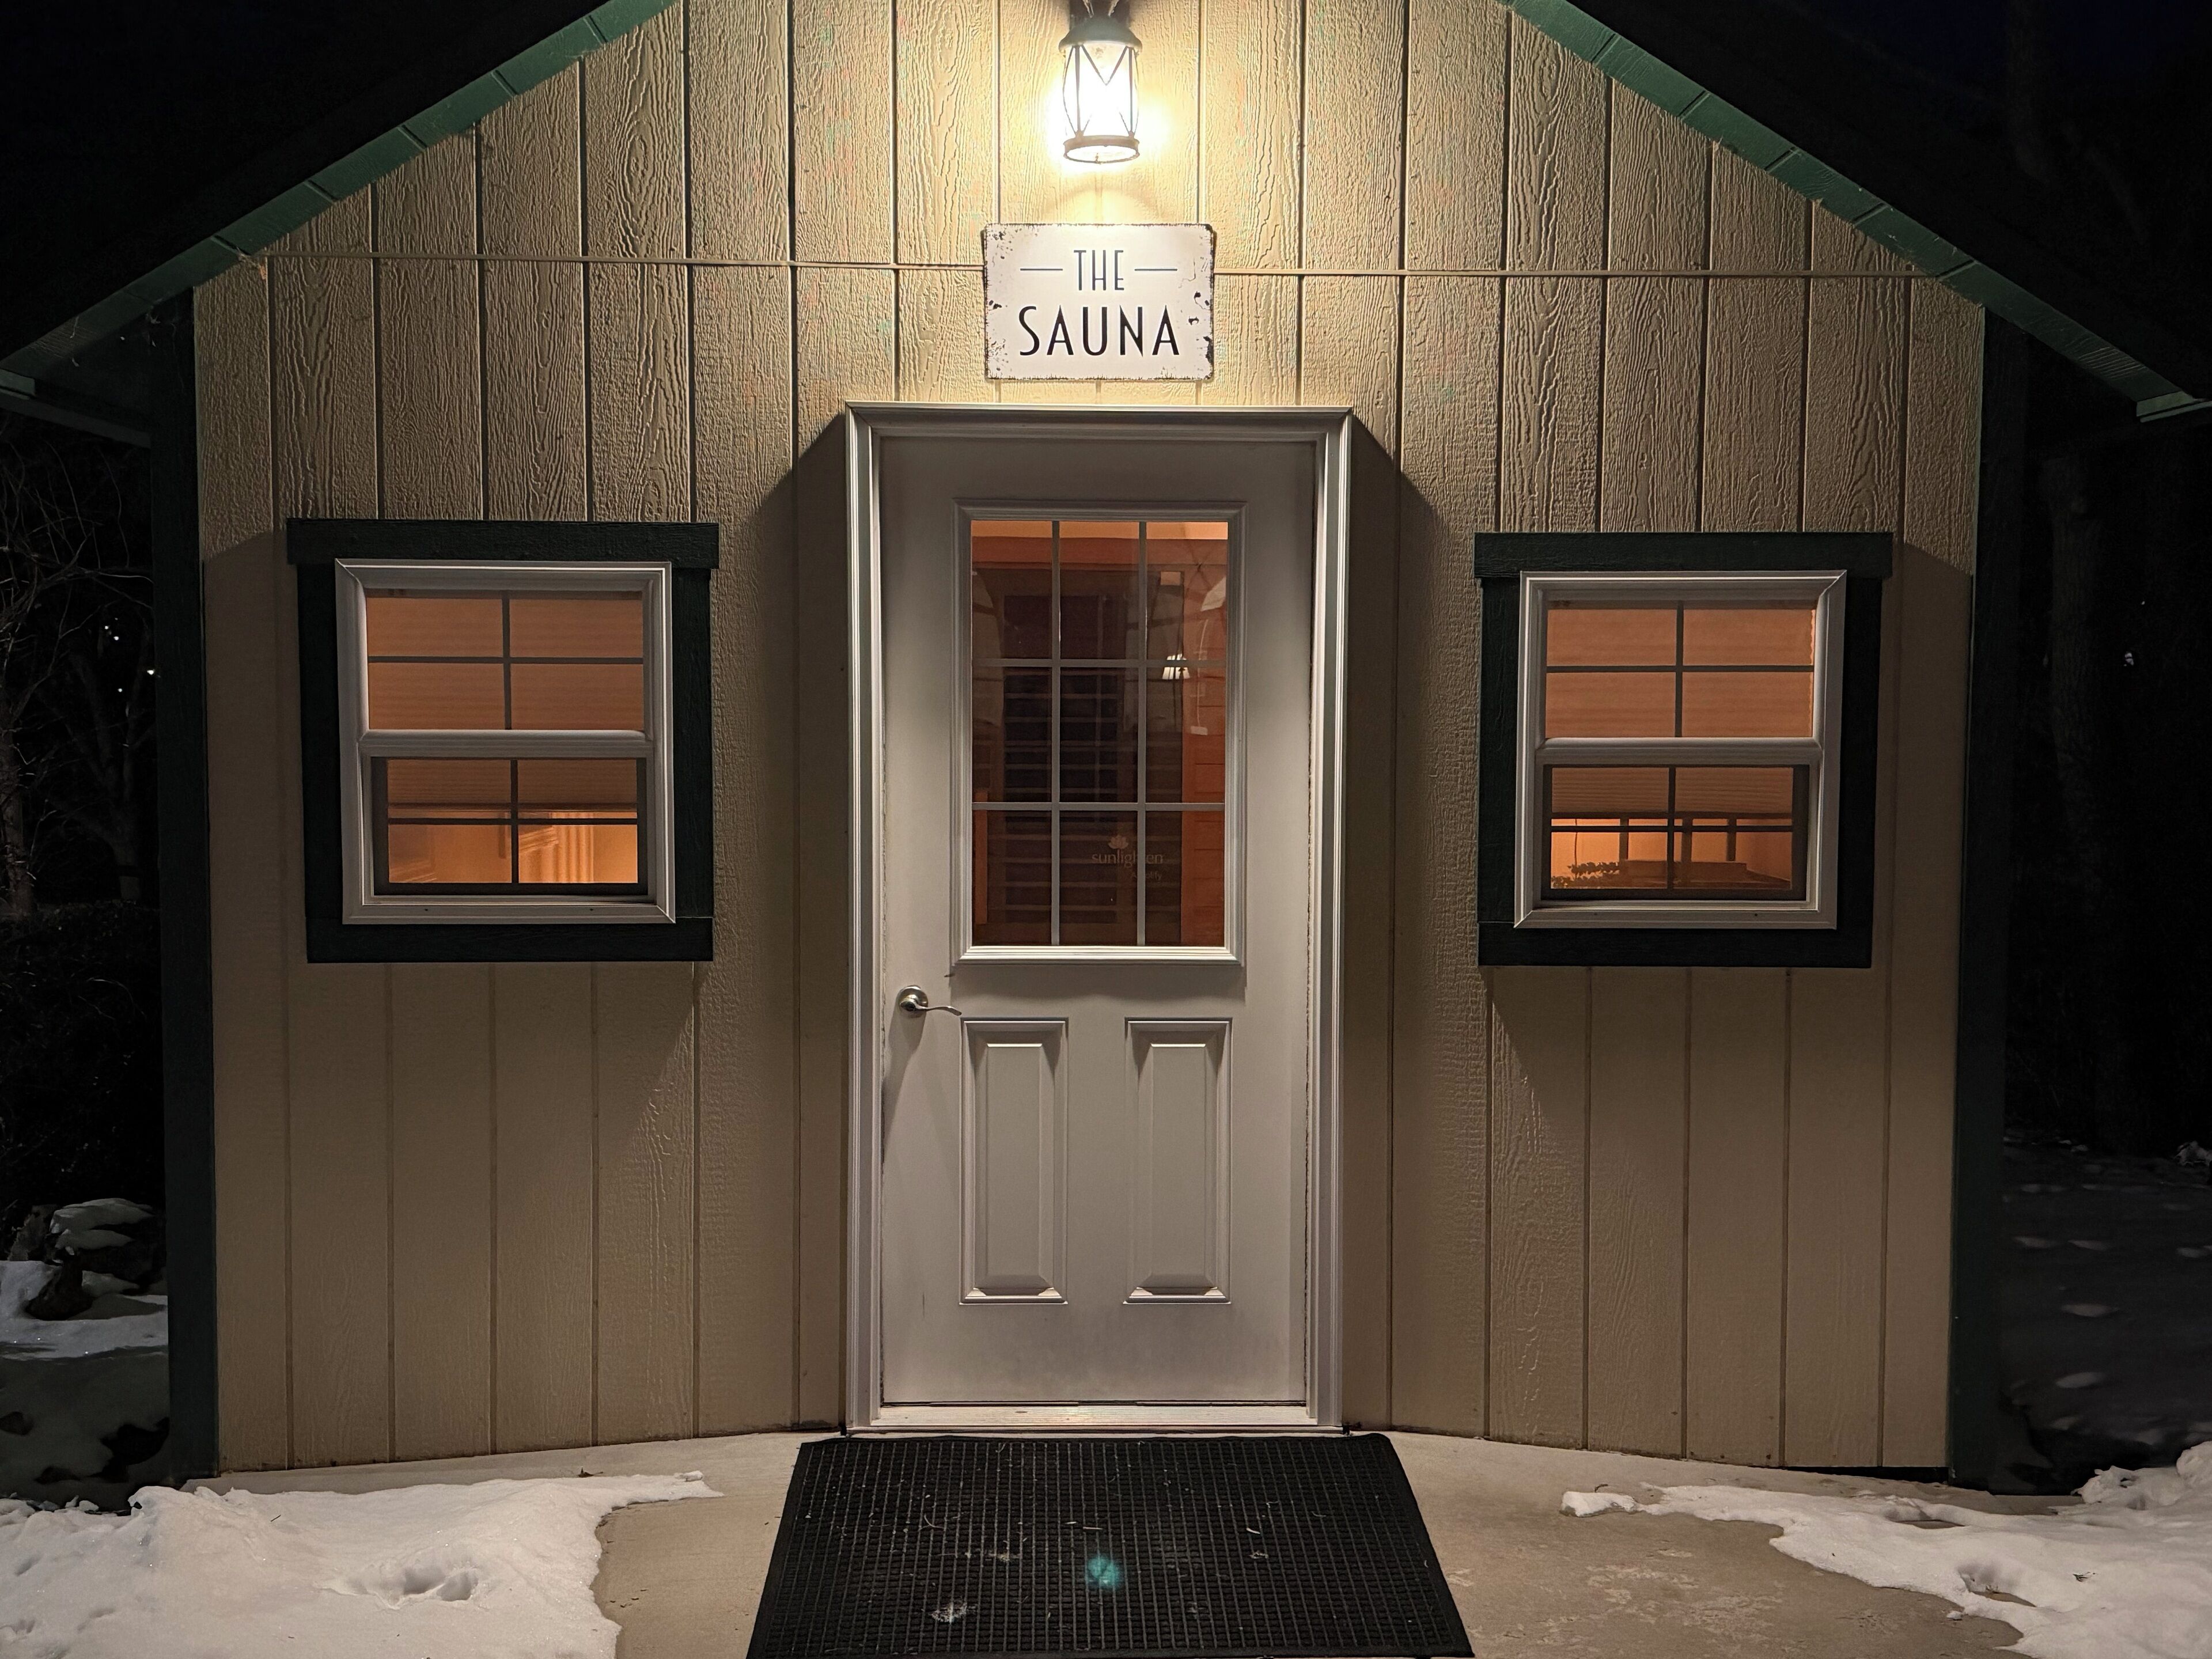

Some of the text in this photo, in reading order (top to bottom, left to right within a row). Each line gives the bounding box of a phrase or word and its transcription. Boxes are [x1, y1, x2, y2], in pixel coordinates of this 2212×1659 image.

[1073, 249, 1125, 291] THE
[1018, 305, 1180, 357] SAUNA
[1092, 849, 1163, 869] sunligen
